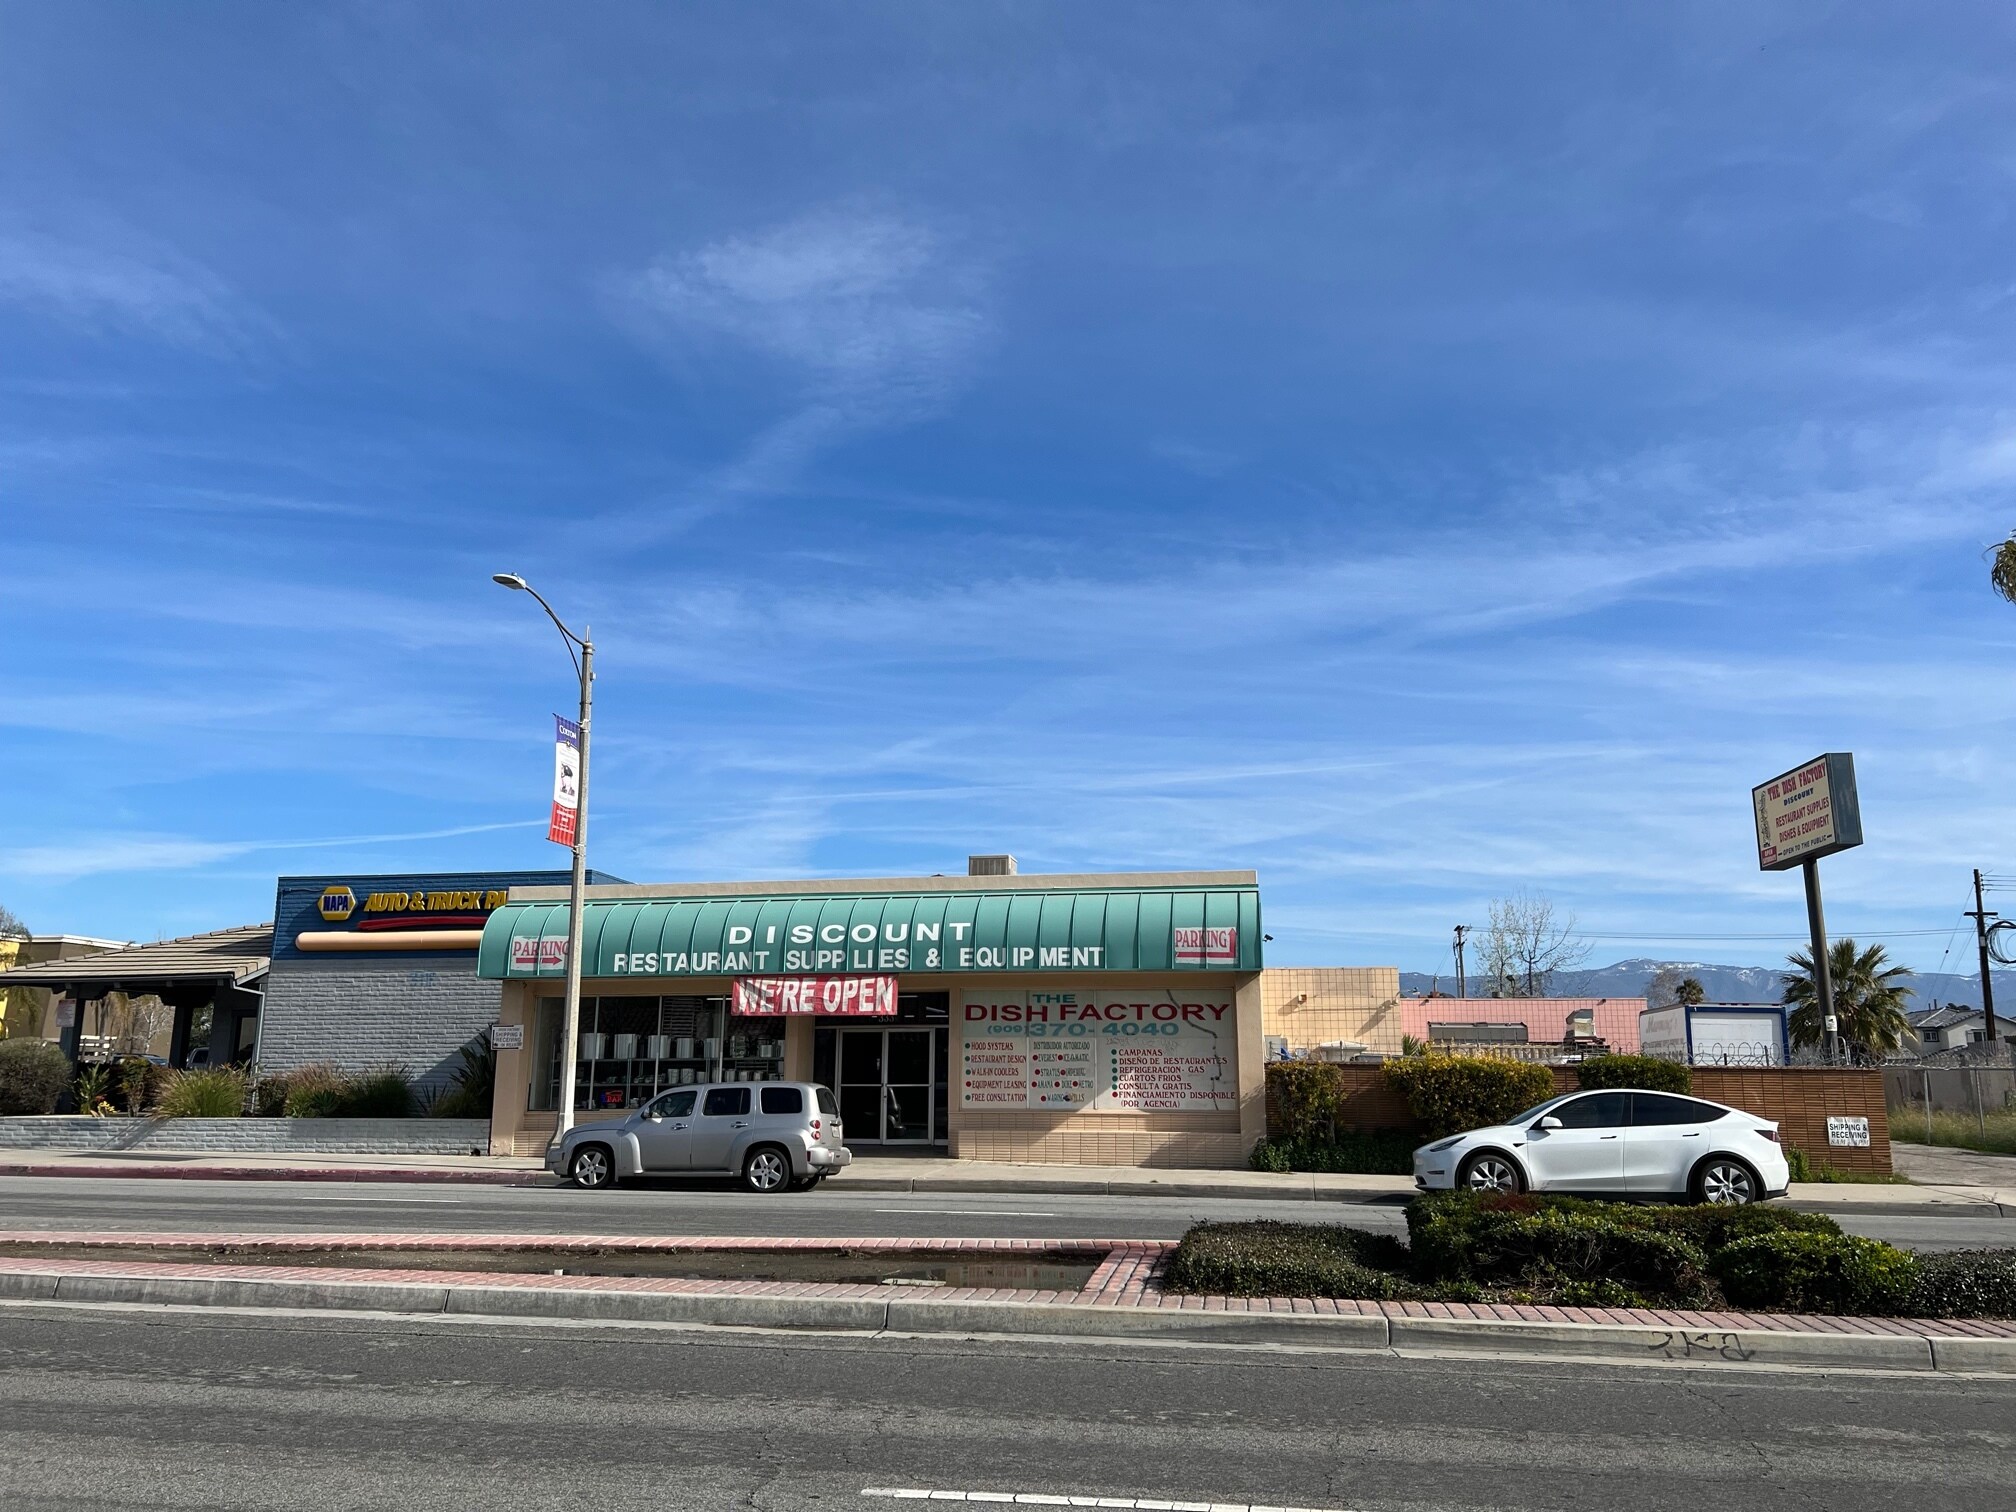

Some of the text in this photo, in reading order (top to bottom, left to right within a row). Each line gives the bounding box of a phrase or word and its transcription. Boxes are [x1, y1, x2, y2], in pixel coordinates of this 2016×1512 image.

[1767, 762, 1827, 801] THE DISH FACTORY
[1783, 787, 1814, 806] DISCOUNT
[1775, 796, 1830, 828] RESTAURANT SUPPLIES
[1779, 814, 1830, 843] DISHES & EQUIPMENT
[1801, 840, 1810, 848] THE
[1810, 834, 1827, 845] PUBLIC
[323, 895, 349, 912] NAPA
[363, 892, 409, 912] AUTO
[408, 891, 425, 911] &
[426, 890, 484, 911] TRUCK
[728, 922, 972, 945] DISCOUNT
[1175, 929, 1228, 948] PARKING
[613, 950, 770, 973] RESTAURANT
[925, 947, 942, 968] &
[959, 946, 1105, 968] EQUIPMENT
[739, 976, 894, 1013] WE'RE OPEN
[1032, 994, 1076, 1004] THE
[965, 1003, 1230, 1023] DISH FACTORY
[971, 1042, 1014, 1051] HOOD SYSTEMS
[1118, 1049, 1163, 1057] CAMPANAS
[970, 1054, 1027, 1063] RESTAURANT DESIGN
[1119, 1056, 1228, 1065] DISEÑO DE RESTAURANTES
[971, 1068, 1019, 1076] WALK-IN COOLERS
[1188, 1065, 1205, 1074] GAS
[1119, 1074, 1182, 1082] CUARTOS FRIOS
[971, 1080, 1027, 1089] EQUIPMENT LEASING
[1118, 1082, 1192, 1090] CONSULTA GRATIS
[971, 1093, 1027, 1102] FREE CONSULTATION
[1118, 1091, 1236, 1100] FINANCIAMIENTO DISPONIBLE
[1120, 1099, 1180, 1109] (POR AGENCIA)
[1829, 1123, 1867, 1131] SHIPPING &
[1831, 1131, 1867, 1139] RECEIVING
